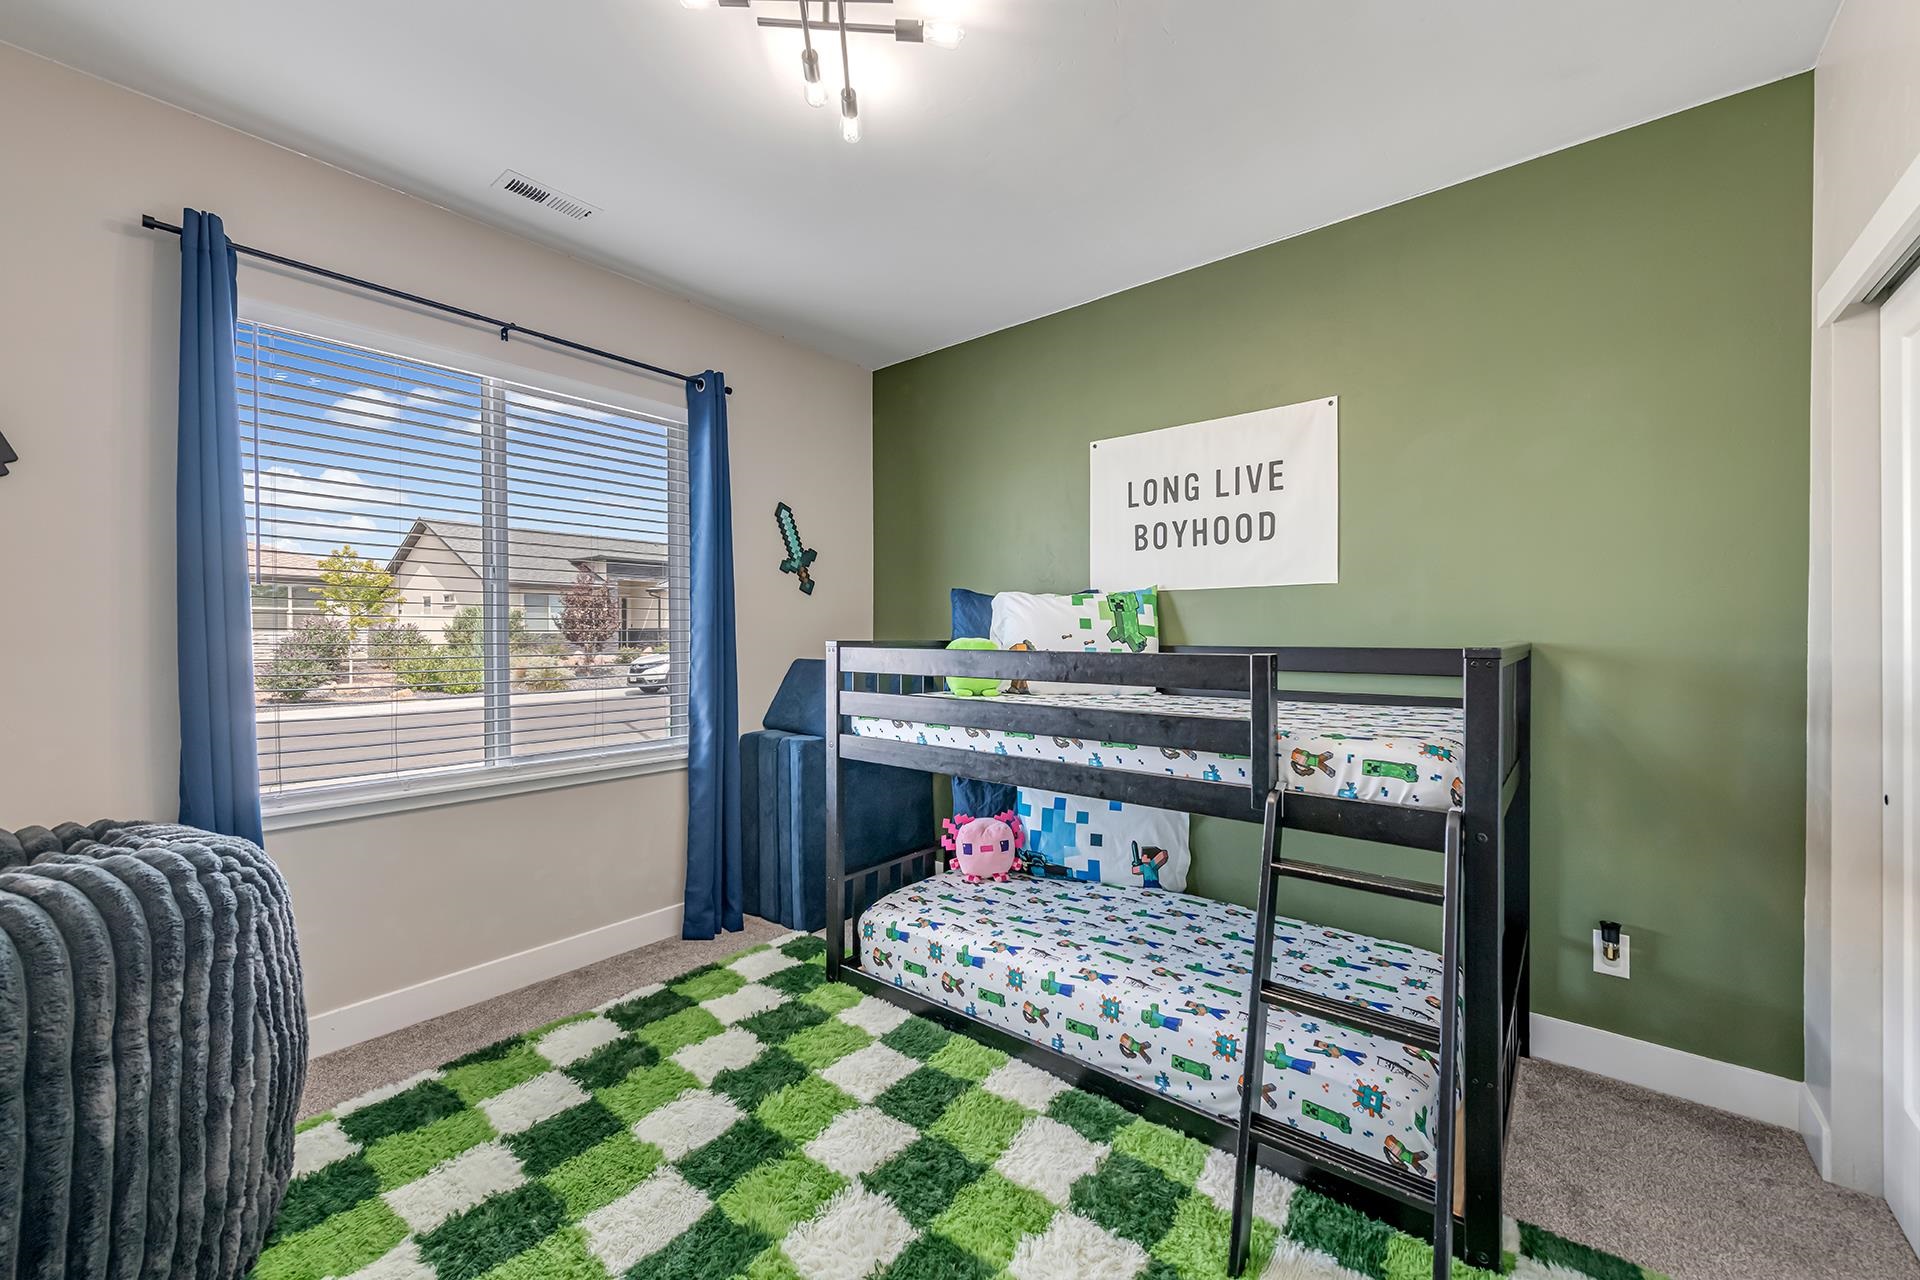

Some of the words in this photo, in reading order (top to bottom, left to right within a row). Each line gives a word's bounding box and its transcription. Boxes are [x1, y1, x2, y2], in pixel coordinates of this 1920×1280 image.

[1127, 472, 1200, 509] LONG
[1215, 459, 1285, 498] LIVE
[1134, 511, 1276, 552] BOYHOOD
